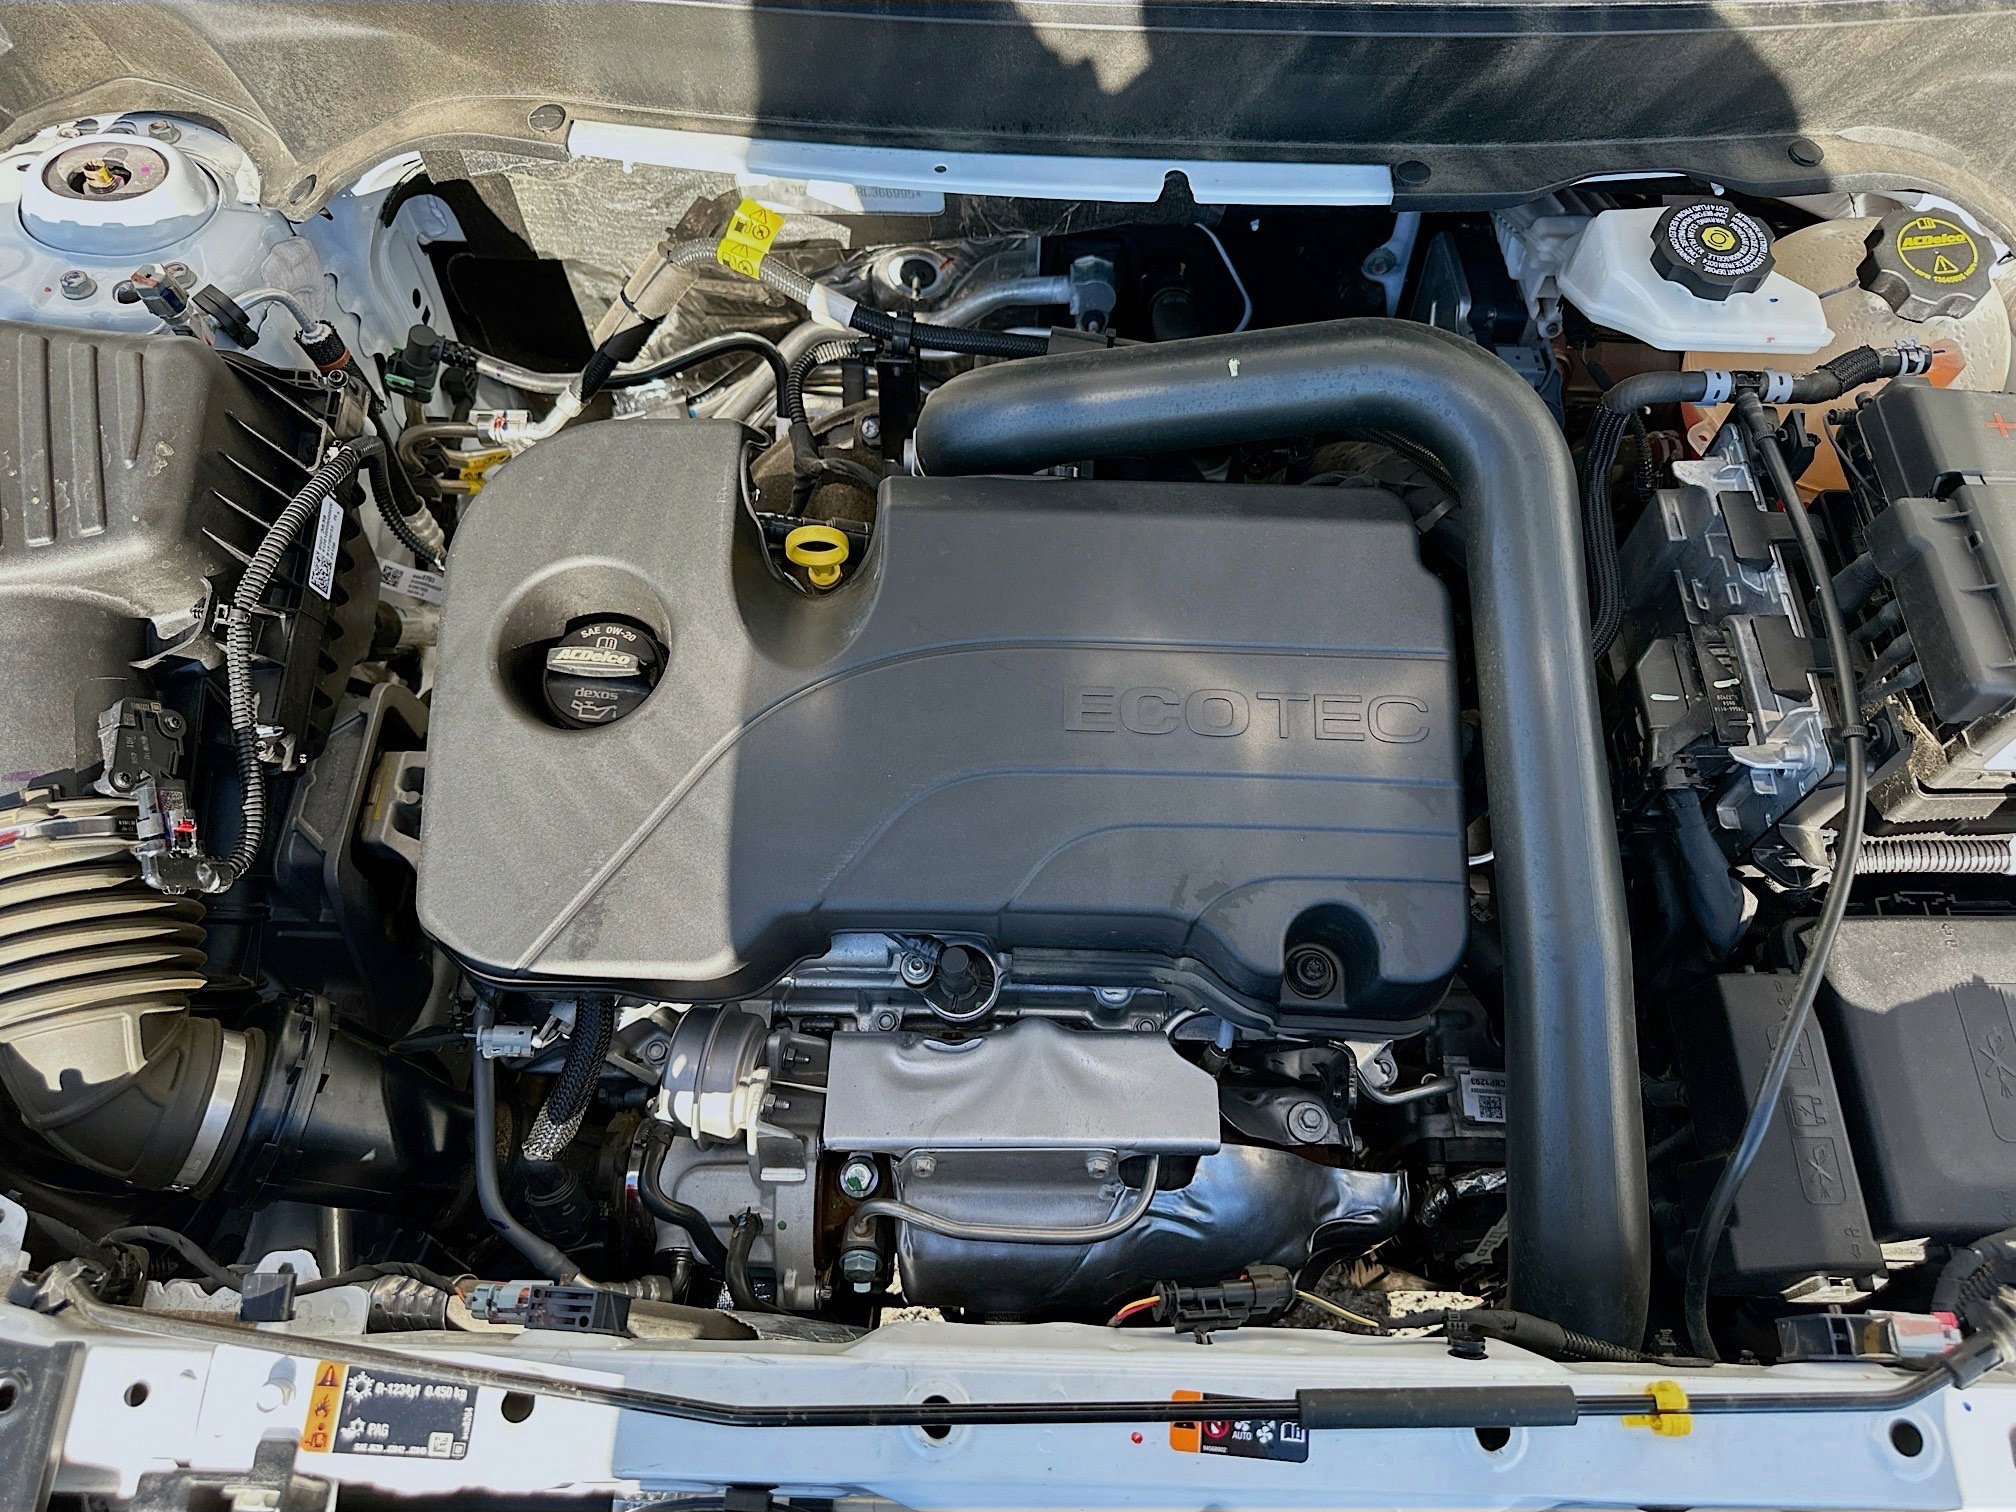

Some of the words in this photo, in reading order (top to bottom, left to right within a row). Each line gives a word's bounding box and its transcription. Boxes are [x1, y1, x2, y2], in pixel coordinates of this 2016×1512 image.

[1902, 233, 1967, 246] ACDelco
[580, 626, 602, 638] SAE
[605, 626, 637, 642] 0W-20
[555, 649, 631, 665] ACDelco
[574, 687, 619, 700] dexos
[1065, 686, 1430, 744] ECOTEC
[366, 1422, 390, 1439] PAG
[1232, 1431, 1252, 1440] AUTO
